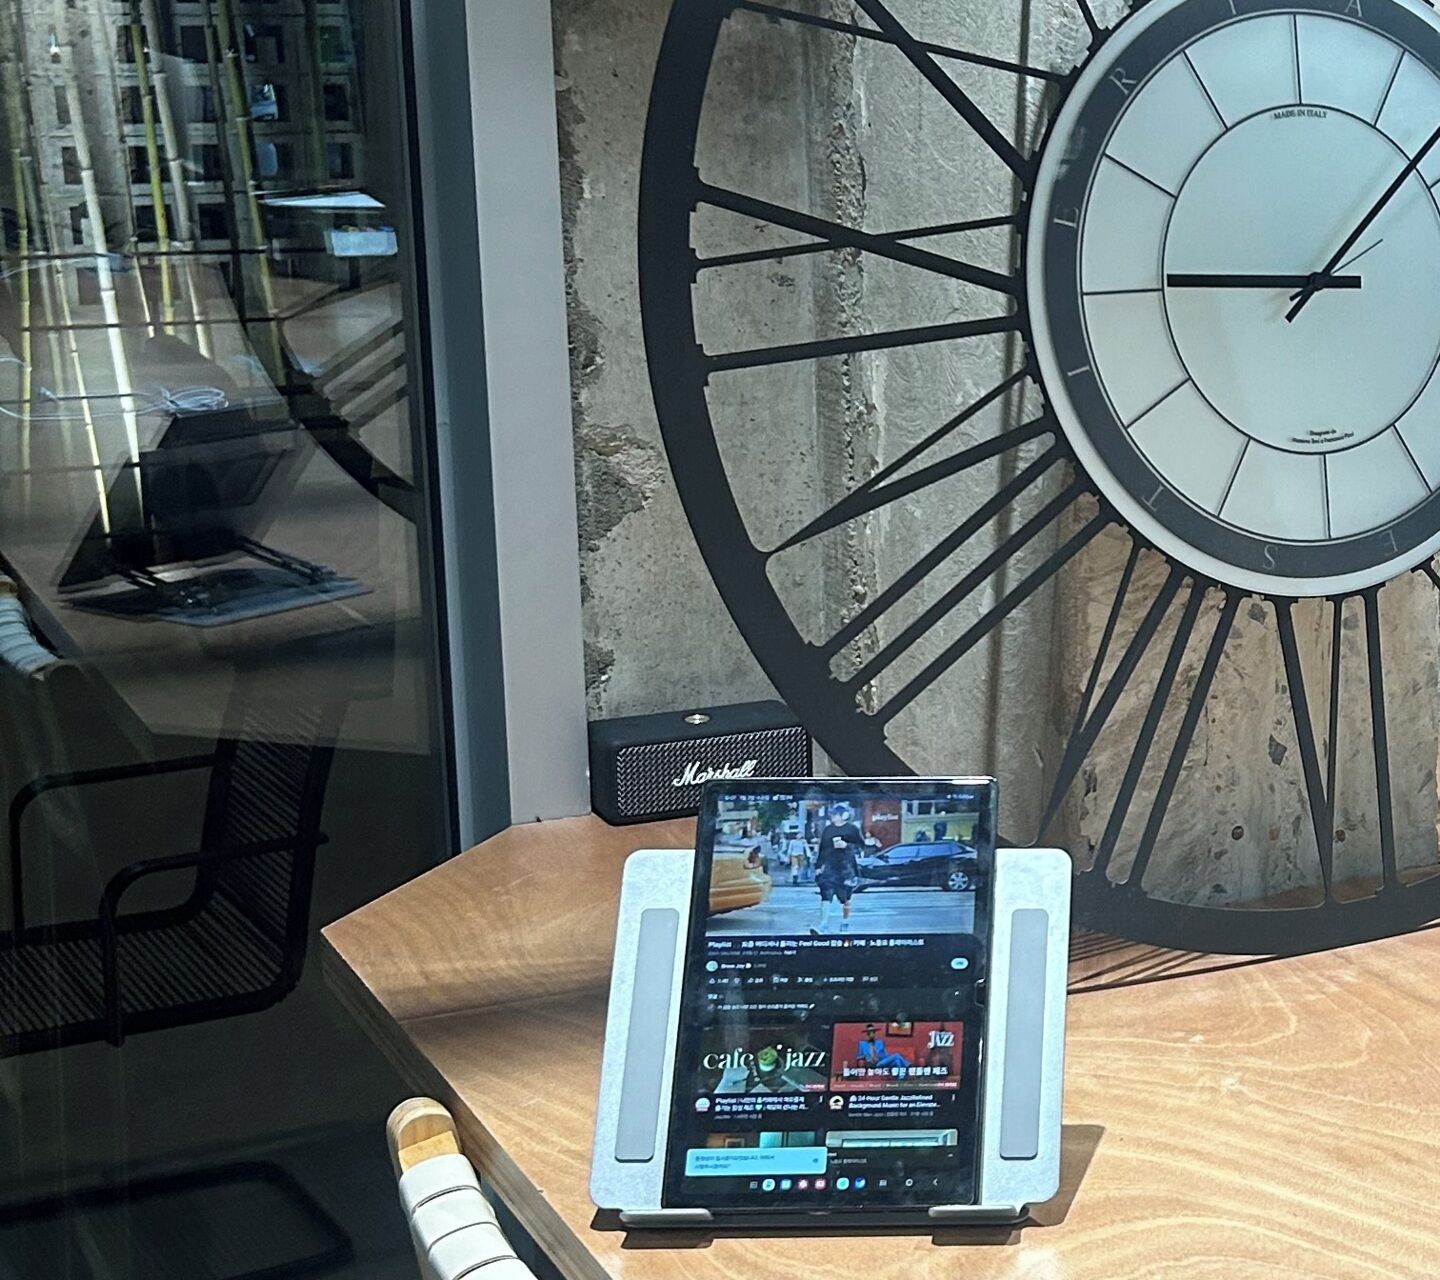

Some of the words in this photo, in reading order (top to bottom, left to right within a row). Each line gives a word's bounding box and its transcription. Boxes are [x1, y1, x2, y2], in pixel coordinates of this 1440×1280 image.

[1274, 110, 1296, 119] MADE
[1297, 109, 1305, 117] IN
[1306, 110, 1328, 119] ITALY
[672, 760, 758, 787] Marshall
[784, 1048, 826, 1071] jazz
